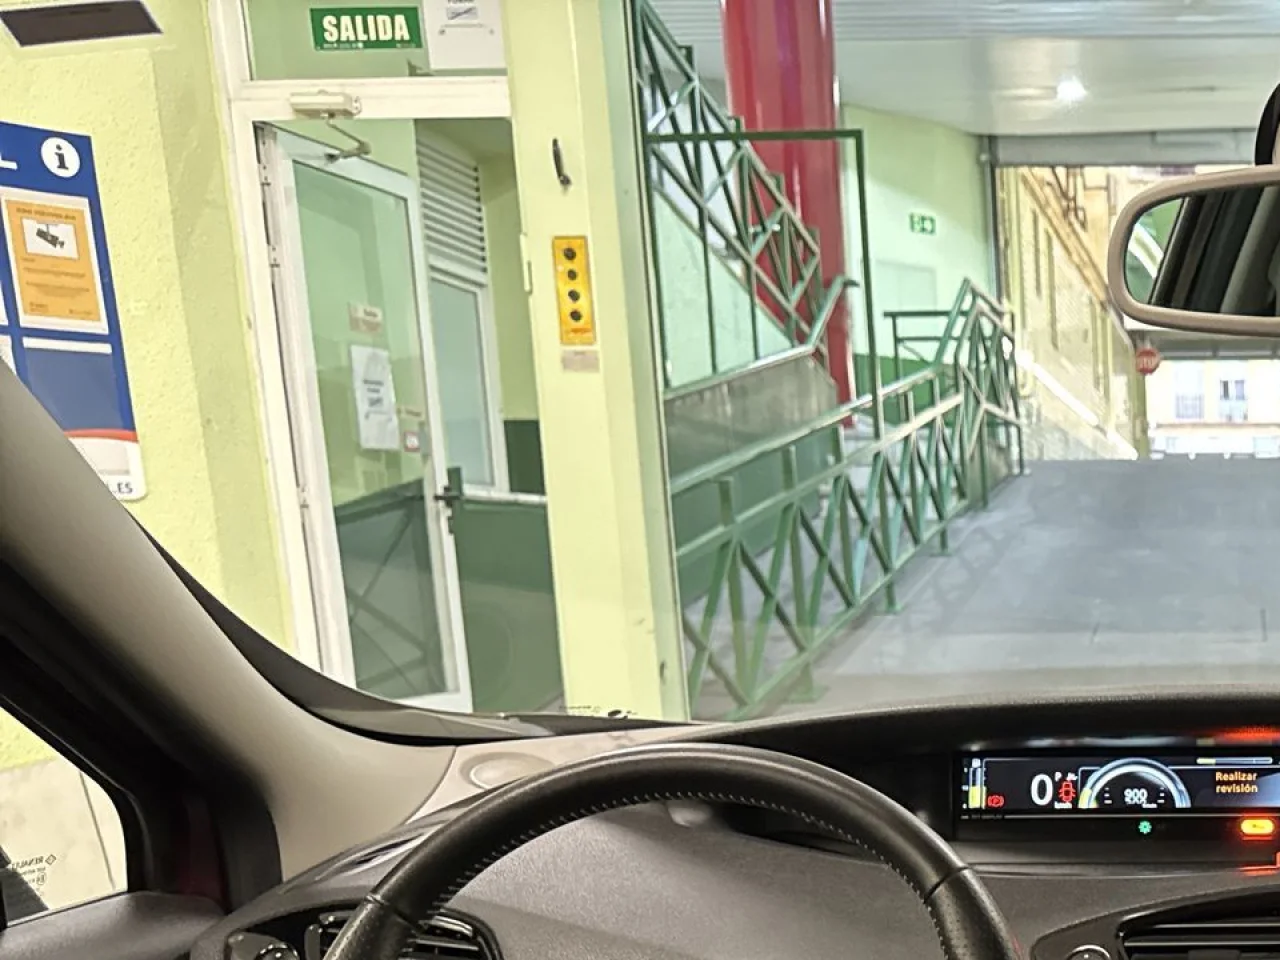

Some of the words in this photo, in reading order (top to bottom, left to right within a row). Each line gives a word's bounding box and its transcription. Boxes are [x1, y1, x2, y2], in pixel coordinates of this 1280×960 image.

[322, 14, 410, 42] SALIDA
[1216, 772, 1257, 781] Realizar
[1030, 773, 1053, 805] 0
[1216, 784, 1258, 794] revisión
